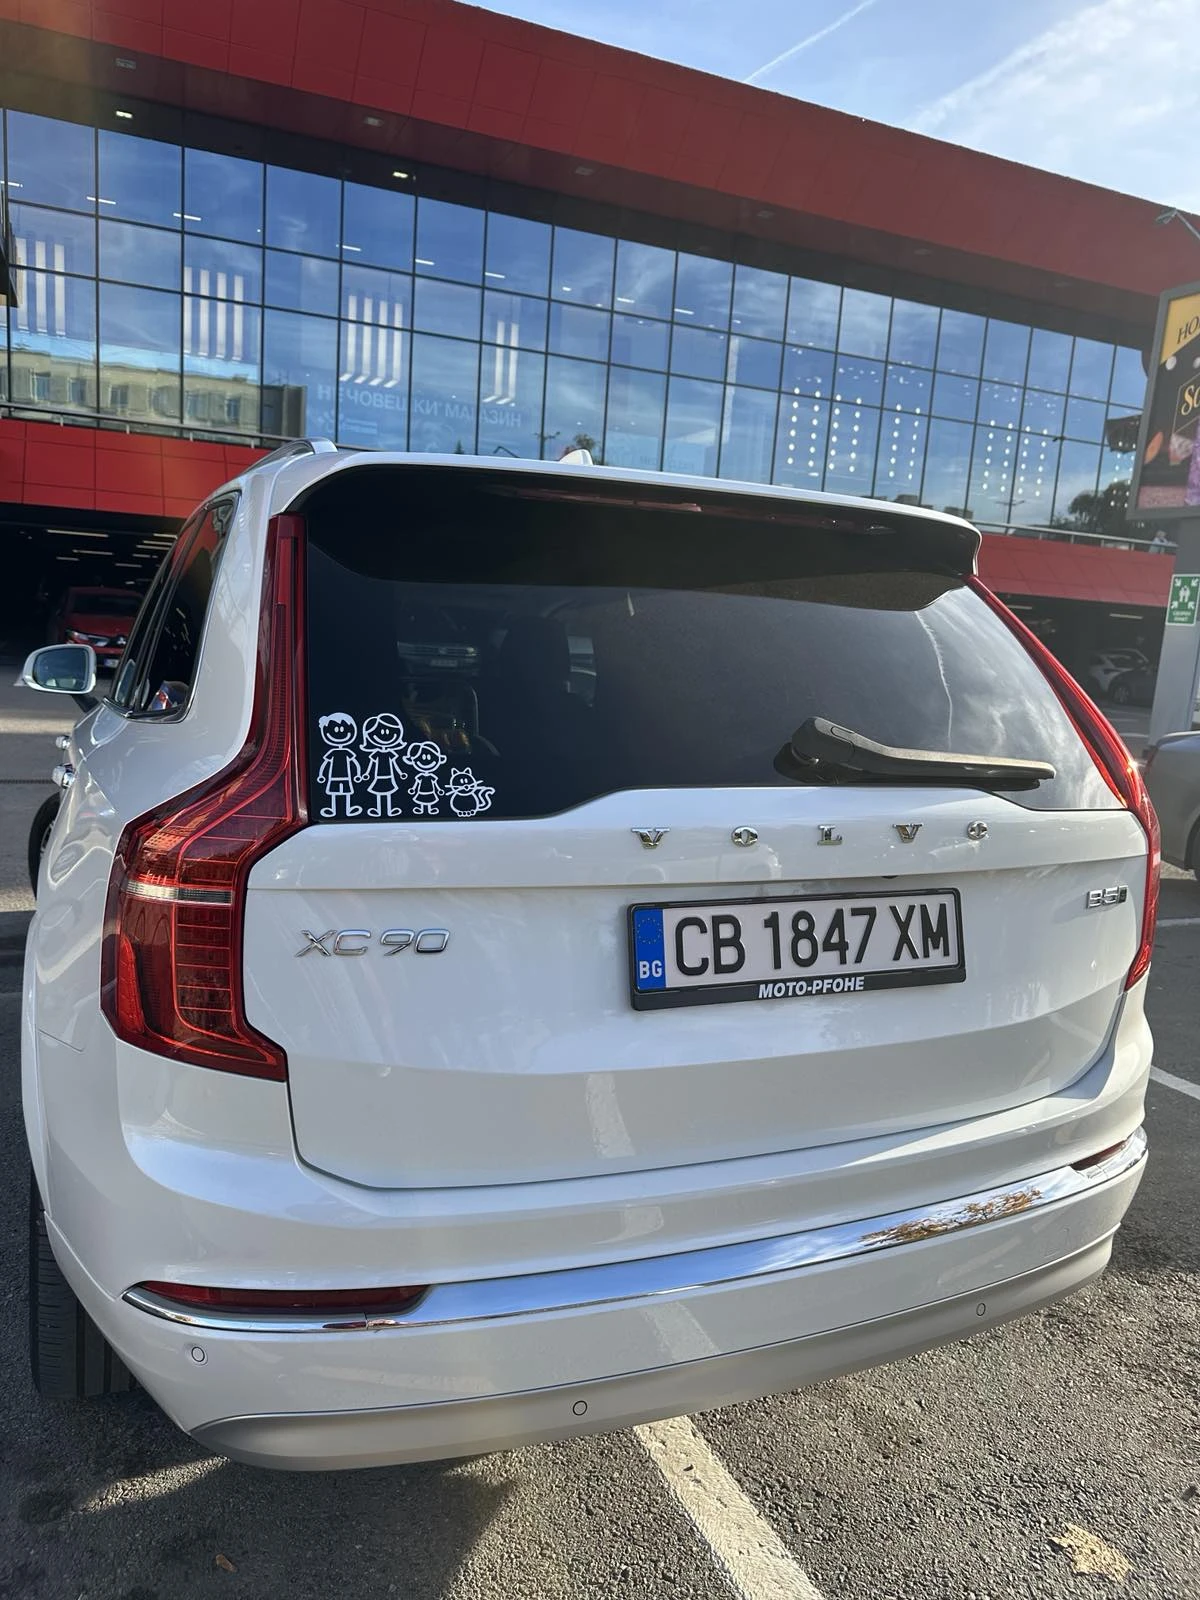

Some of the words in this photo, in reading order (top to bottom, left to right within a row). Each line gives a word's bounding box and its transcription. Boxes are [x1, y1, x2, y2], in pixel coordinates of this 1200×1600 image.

[1177, 315, 1200, 345] HO
[631, 820, 990, 849] VOLVO
[675, 914, 746, 976] CB
[764, 906, 877, 970] 1847
[889, 902, 951, 961] XM
[639, 959, 663, 980] BG
[758, 976, 865, 999] MOTO-PFOHE
